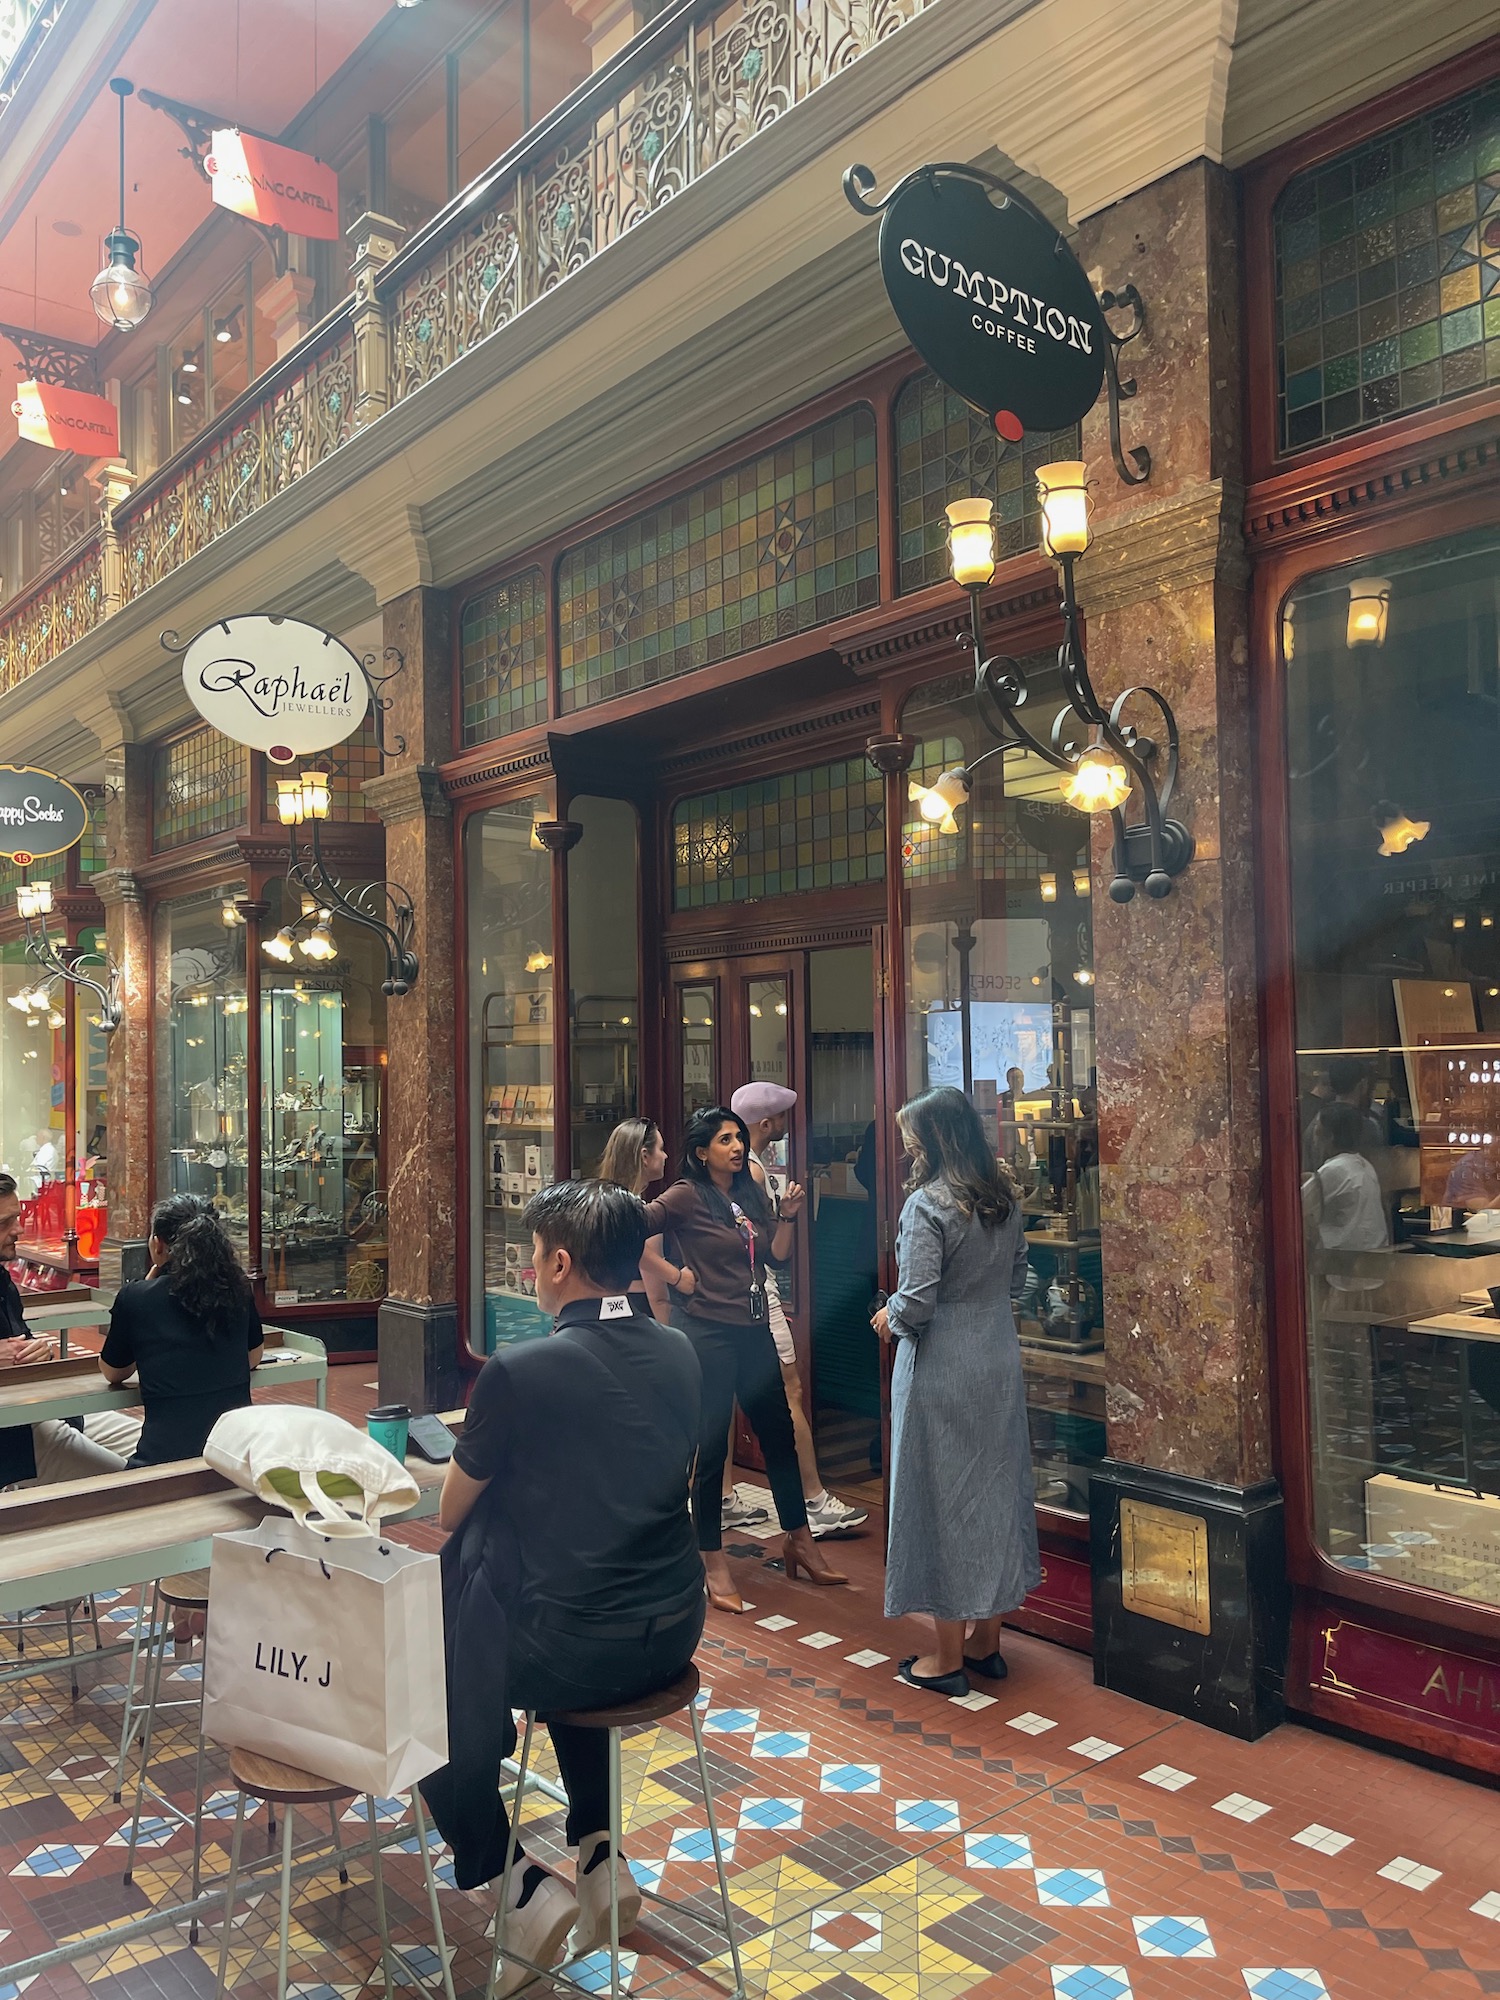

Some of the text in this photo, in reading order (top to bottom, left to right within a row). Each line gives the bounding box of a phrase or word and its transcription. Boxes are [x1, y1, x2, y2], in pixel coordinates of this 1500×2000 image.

[900, 238, 1093, 355] GUMPTION
[971, 314, 1036, 354] COFFEE
[199, 658, 352, 717] Raphaël
[282, 701, 352, 717] JEWELLERS
[23, 795, 65, 822] Socks
[17, 854, 29, 863] 15
